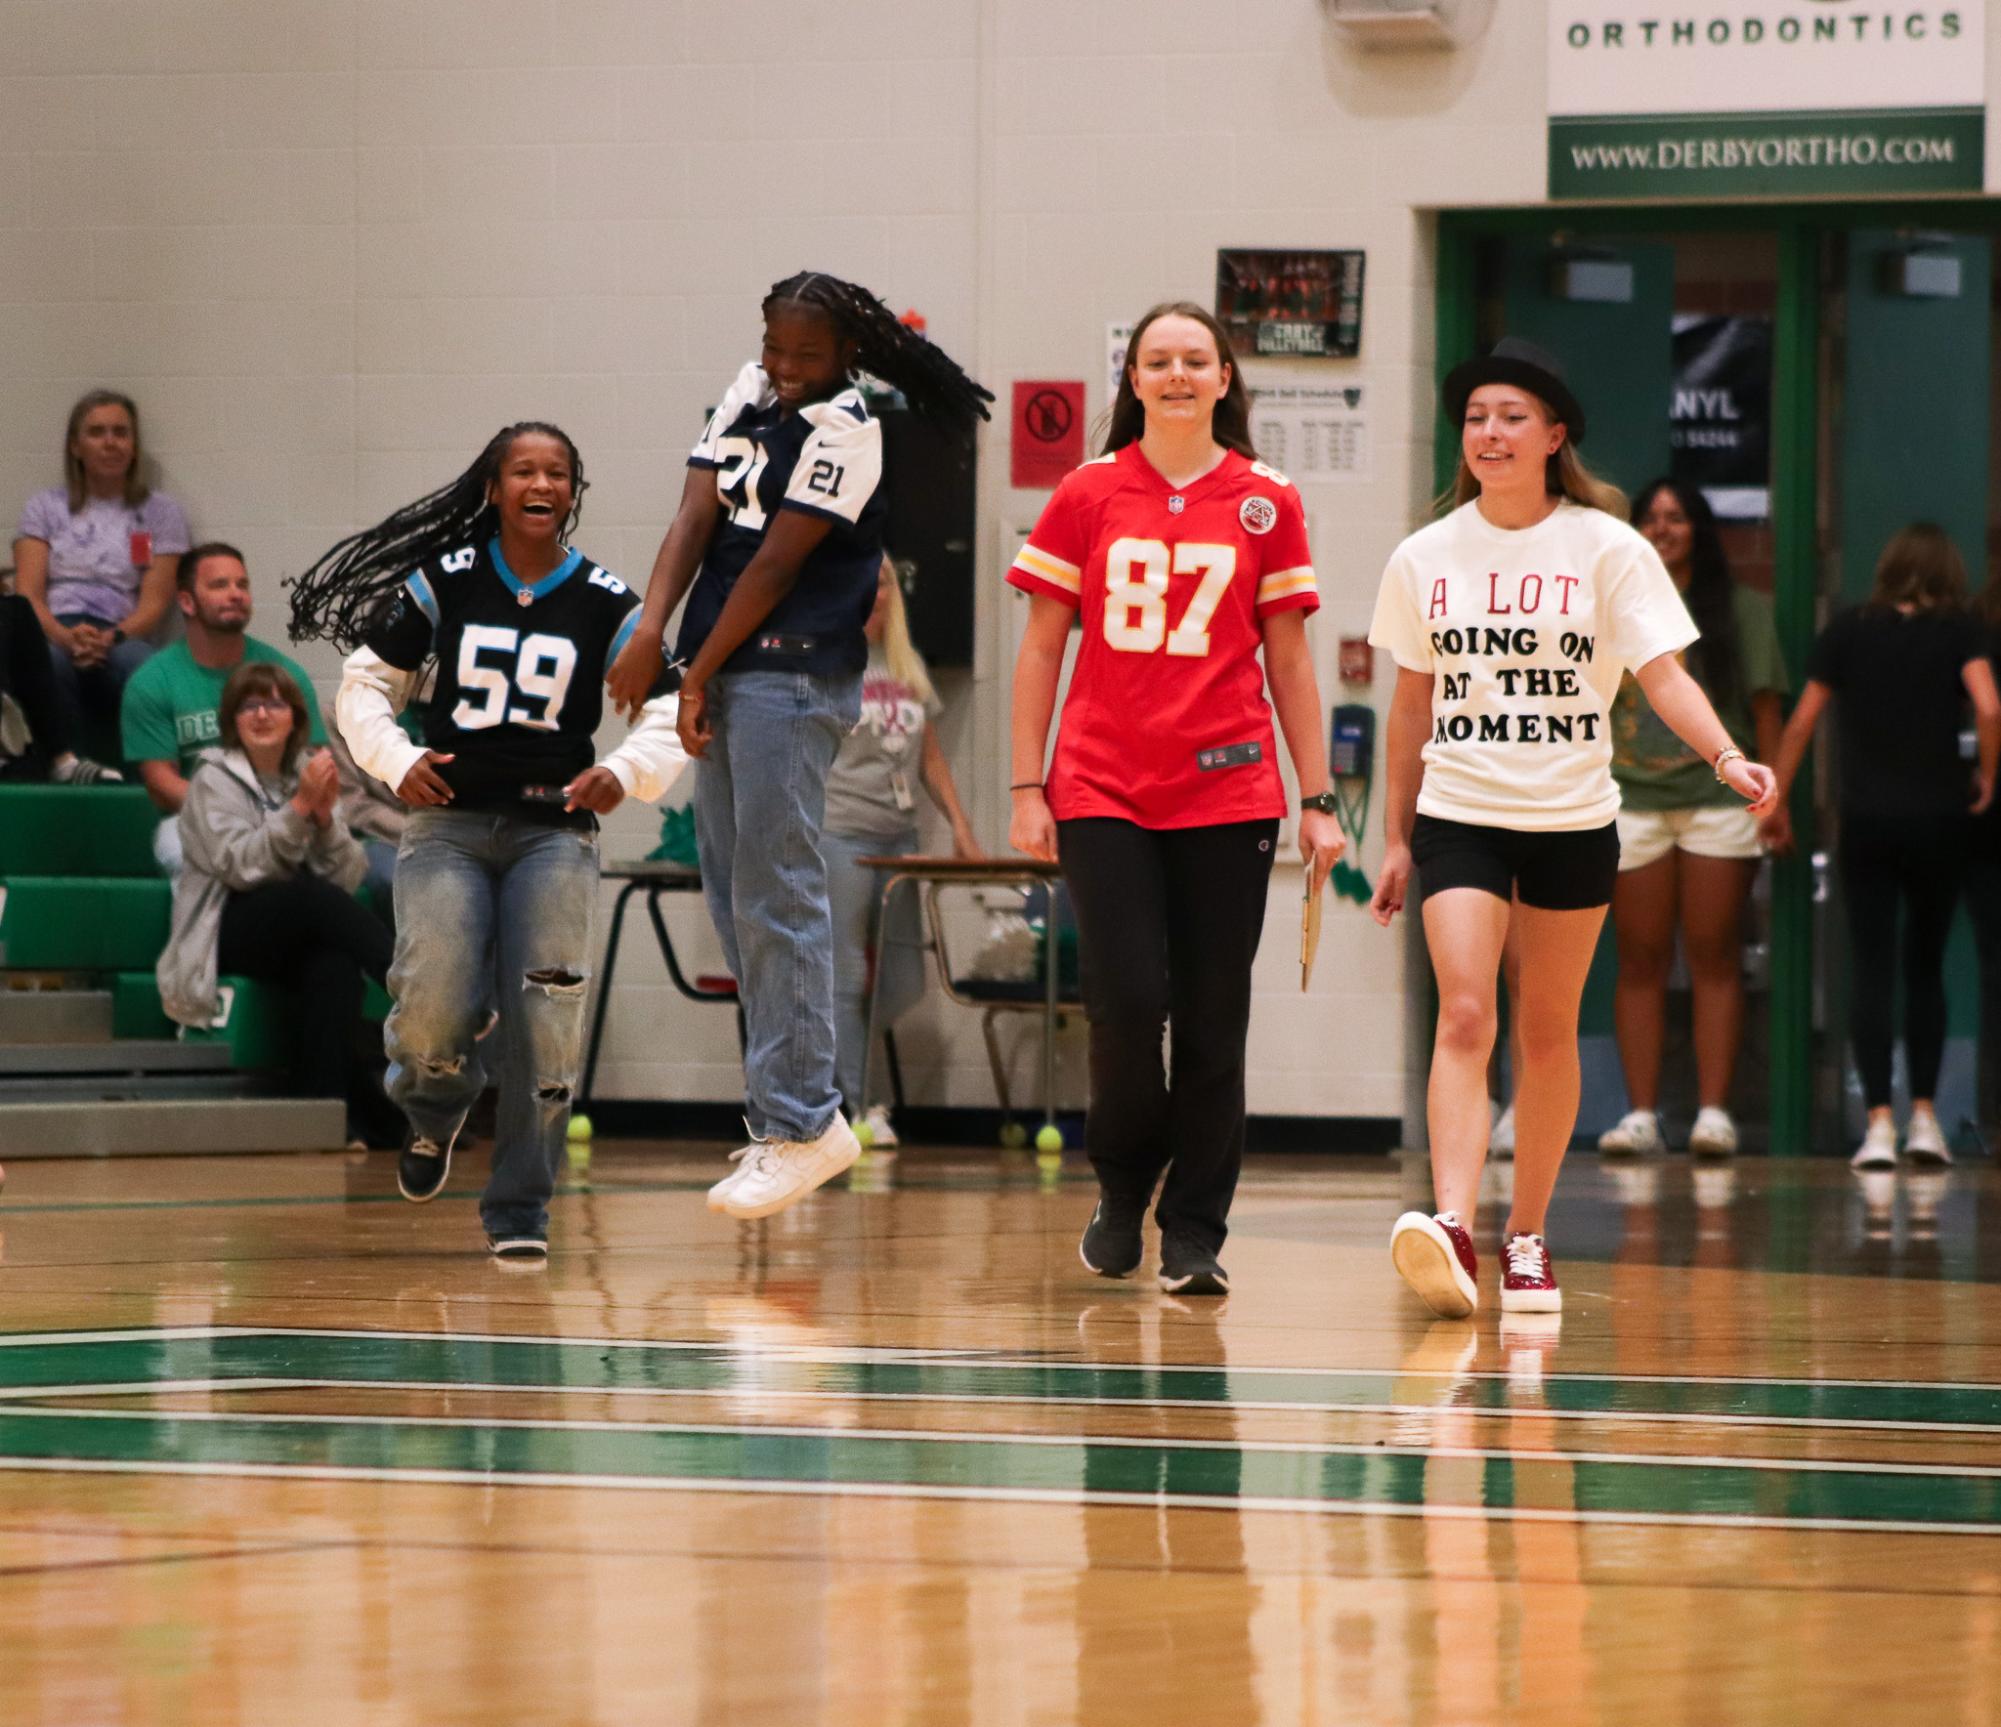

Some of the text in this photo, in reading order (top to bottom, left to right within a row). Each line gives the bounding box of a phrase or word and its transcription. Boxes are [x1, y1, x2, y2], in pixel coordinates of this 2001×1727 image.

[1567, 13, 1962, 49] ORTHODONTICS
[1571, 137, 1955, 171] WWW.DERBYORTHO.COM
[1670, 390, 1740, 419] NYL
[714, 436, 770, 531] 21
[807, 459, 845, 498] 21
[1102, 537, 1237, 658] 87
[1428, 572, 1580, 620] A LOT
[1430, 626, 1596, 664] GOING ON
[451, 623, 578, 732] 59
[1443, 668, 1581, 701] AT THE
[1434, 712, 1600, 745] MOMENT
